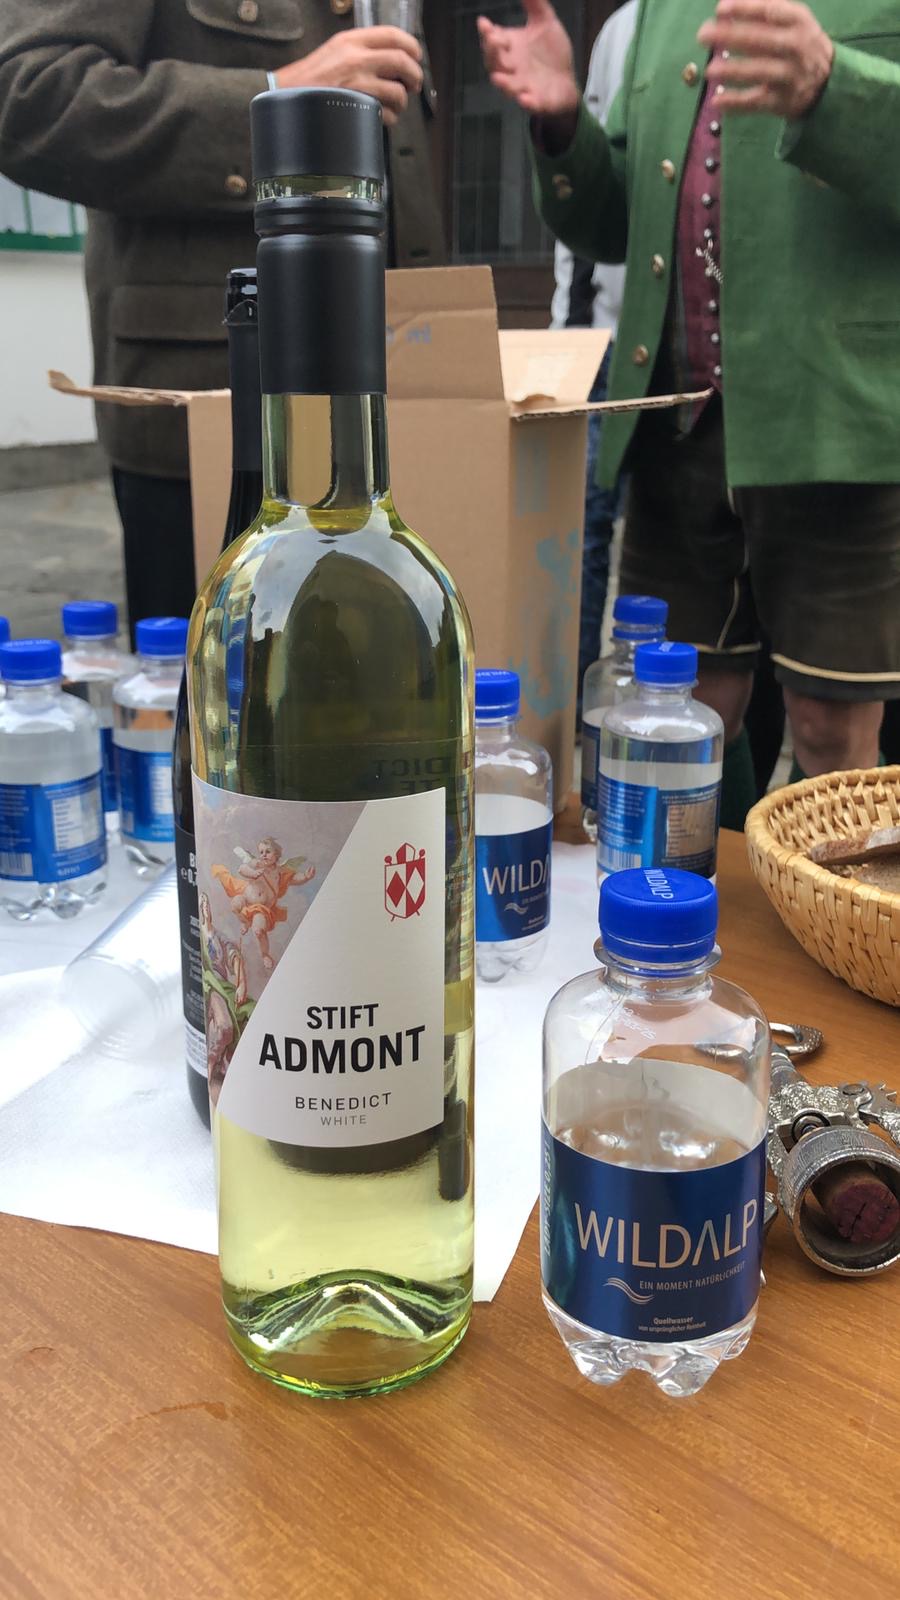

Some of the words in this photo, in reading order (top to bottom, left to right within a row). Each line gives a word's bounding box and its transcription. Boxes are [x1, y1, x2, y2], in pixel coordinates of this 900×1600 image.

[306, 1003, 379, 1029] STIFT
[258, 1025, 426, 1074] ADMONT
[295, 1092, 392, 1110] BENEDICT
[320, 1114, 368, 1126] WHITE
[574, 1198, 758, 1269] WILDALP
[639, 1280, 654, 1291] EIN
[656, 1279, 693, 1291] MOMENT
[695, 1260, 746, 1288] NATÜRLICHKEIT
